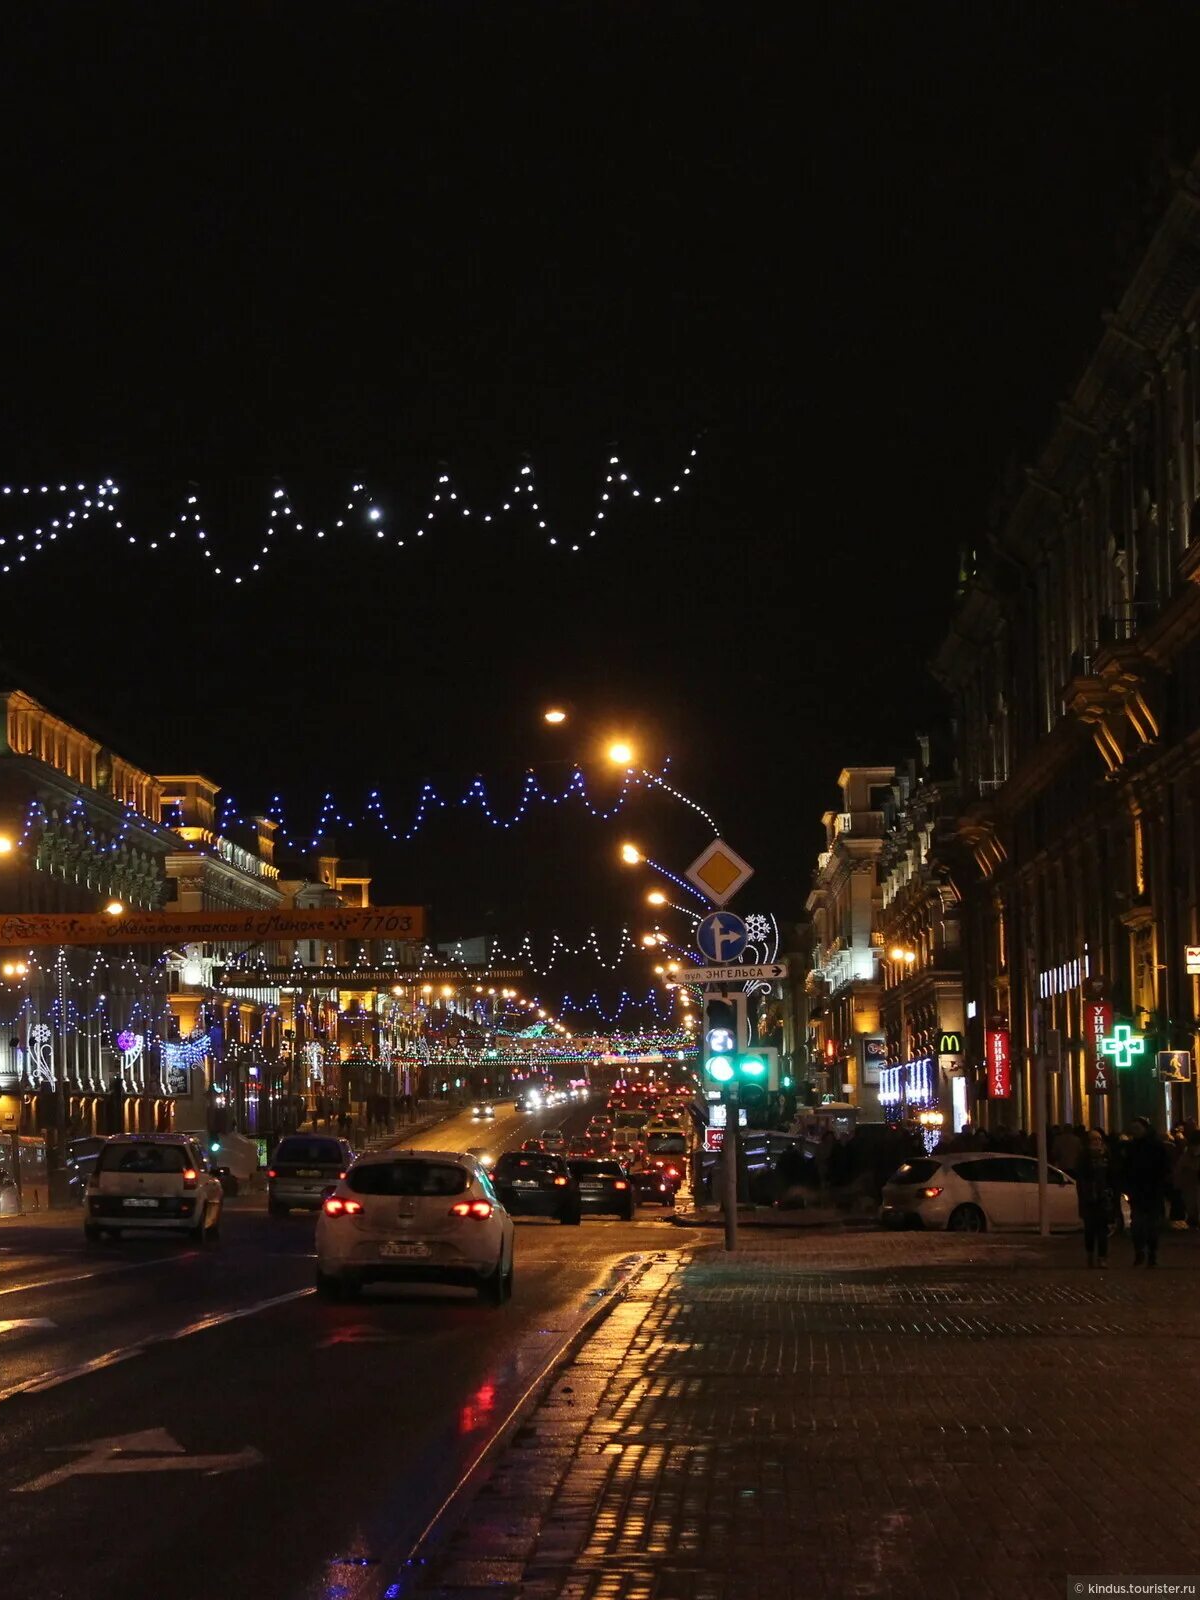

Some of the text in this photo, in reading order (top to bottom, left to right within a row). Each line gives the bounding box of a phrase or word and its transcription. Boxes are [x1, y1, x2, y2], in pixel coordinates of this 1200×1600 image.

[361, 915, 413, 932] 7703
[706, 968, 764, 979] ЭНГЕЛЬСА
[994, 1033, 1004, 1096] УНИВЕРСАМ
[1093, 1006, 1107, 1089] УНИВЕРСАМ
